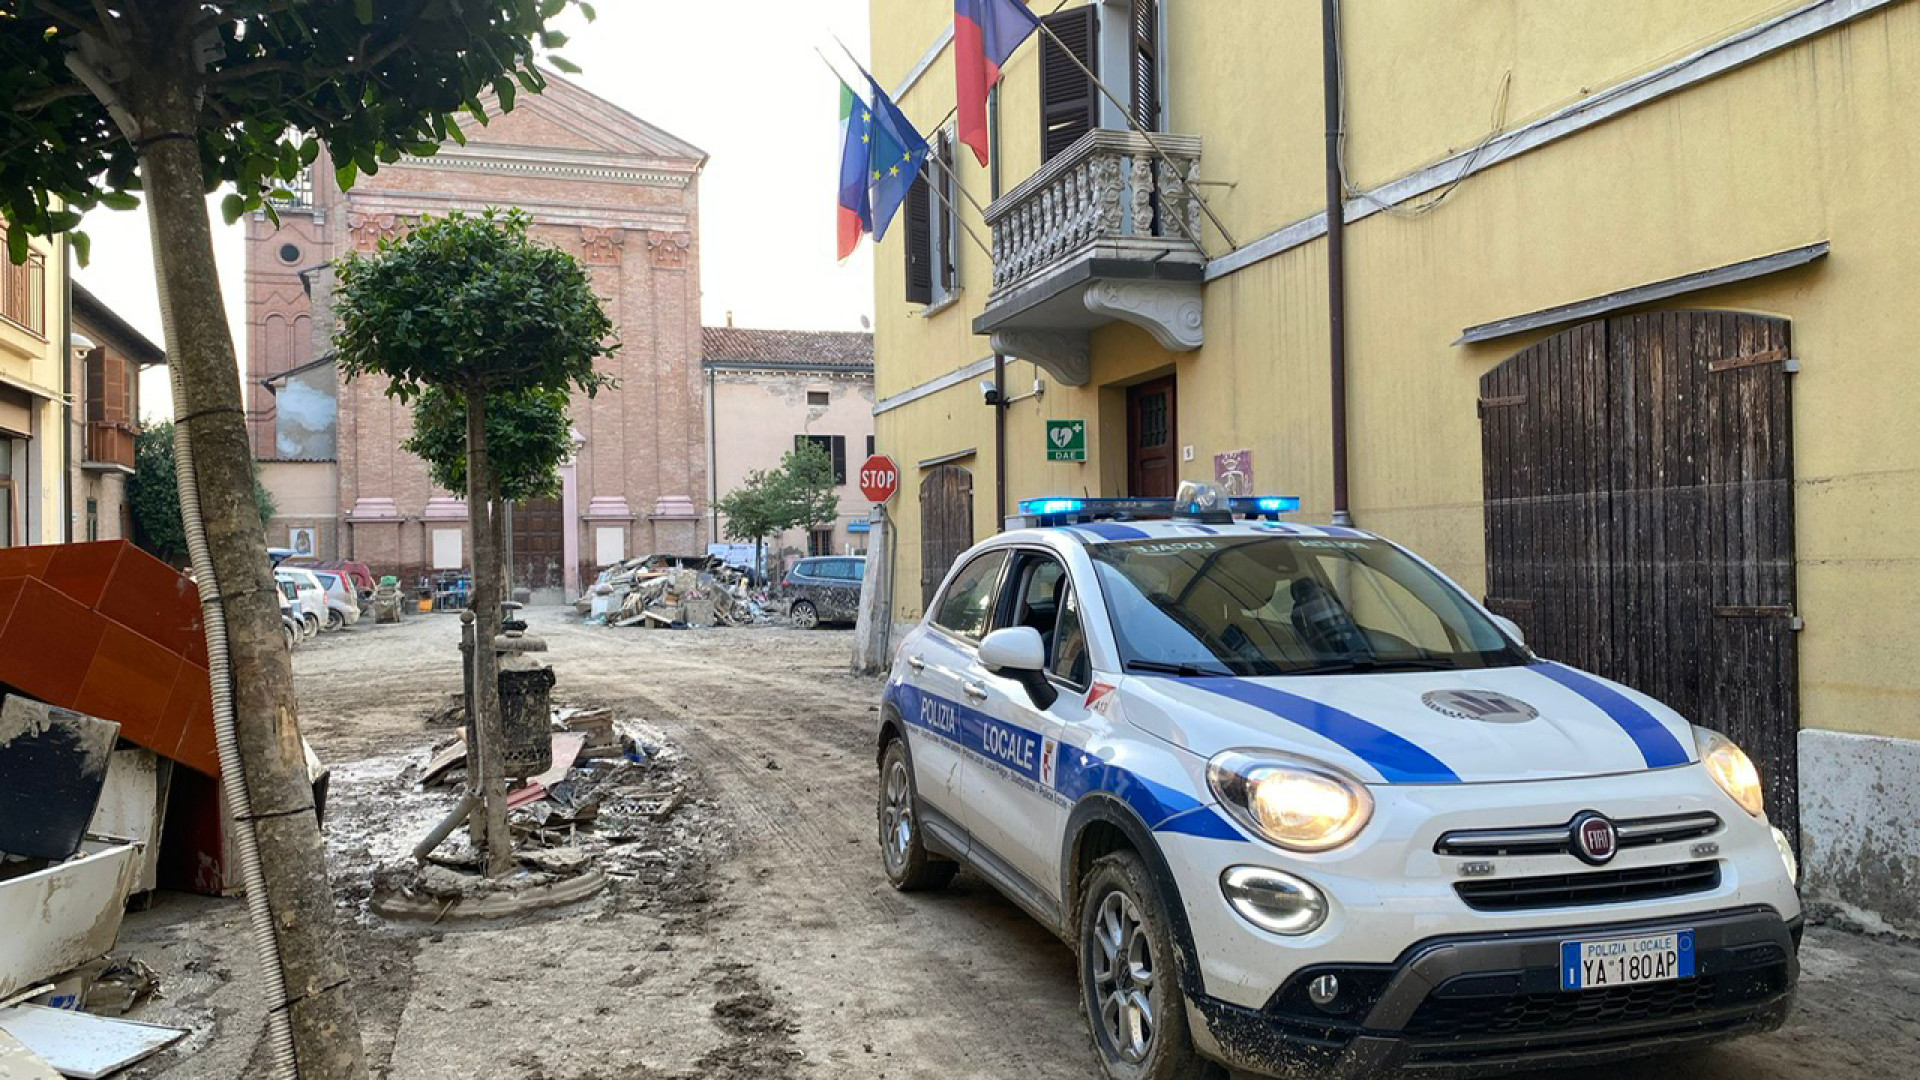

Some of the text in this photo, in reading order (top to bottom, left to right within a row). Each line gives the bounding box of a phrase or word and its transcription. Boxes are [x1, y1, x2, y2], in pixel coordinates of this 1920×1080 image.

[1055, 451, 1077, 460] DAE
[861, 470, 895, 489] STOP
[920, 696, 956, 735] POLIZIA
[983, 722, 1035, 772] LOCALE
[1587, 829, 1609, 850] FIAT
[1588, 937, 1672, 958] POLIZIA LOCALE
